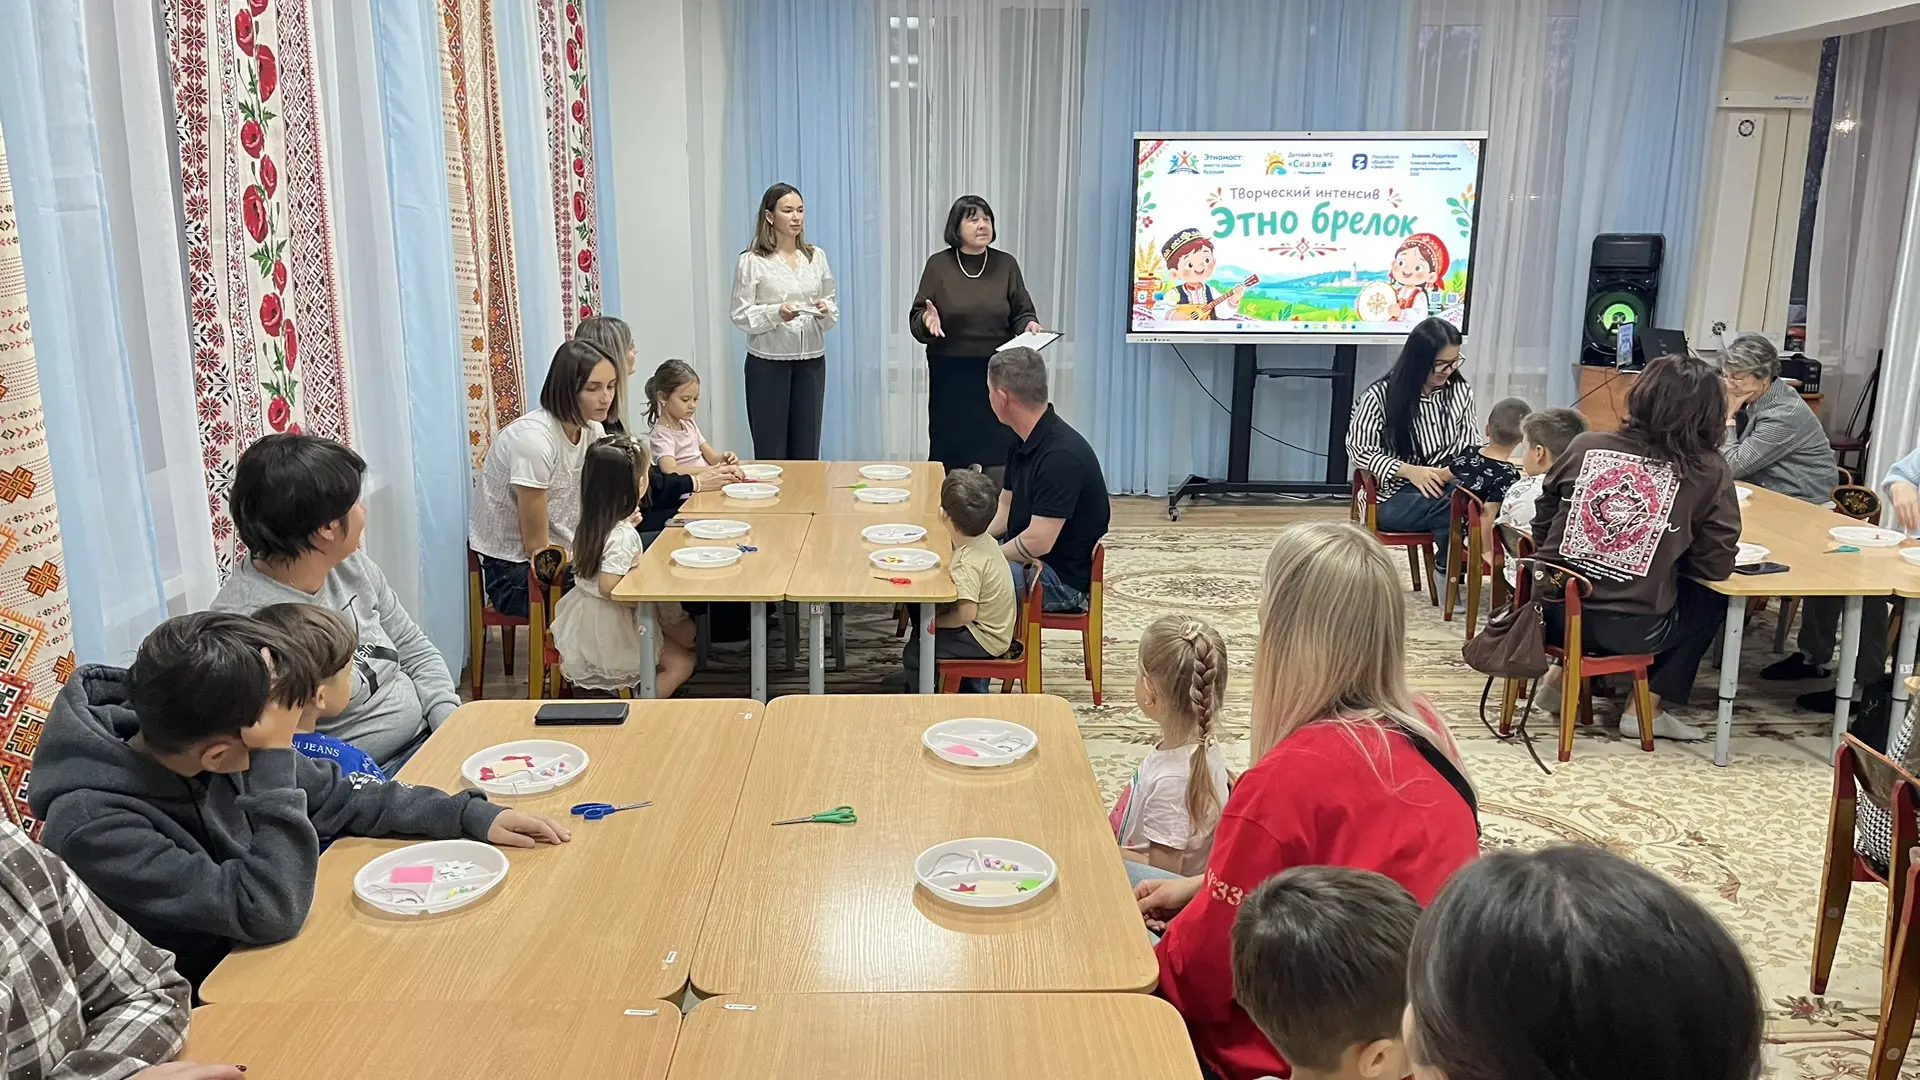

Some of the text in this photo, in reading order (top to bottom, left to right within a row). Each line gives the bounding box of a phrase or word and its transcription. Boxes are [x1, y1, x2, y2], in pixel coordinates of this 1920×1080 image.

[1203, 153, 1244, 161] Этномост:
[1288, 159, 1332, 168] «Сказка»
[1230, 187, 1380, 202] Творческий интенсив
[1211, 201, 1418, 242] Этно брелок
[303, 742, 340, 758] JEANS
